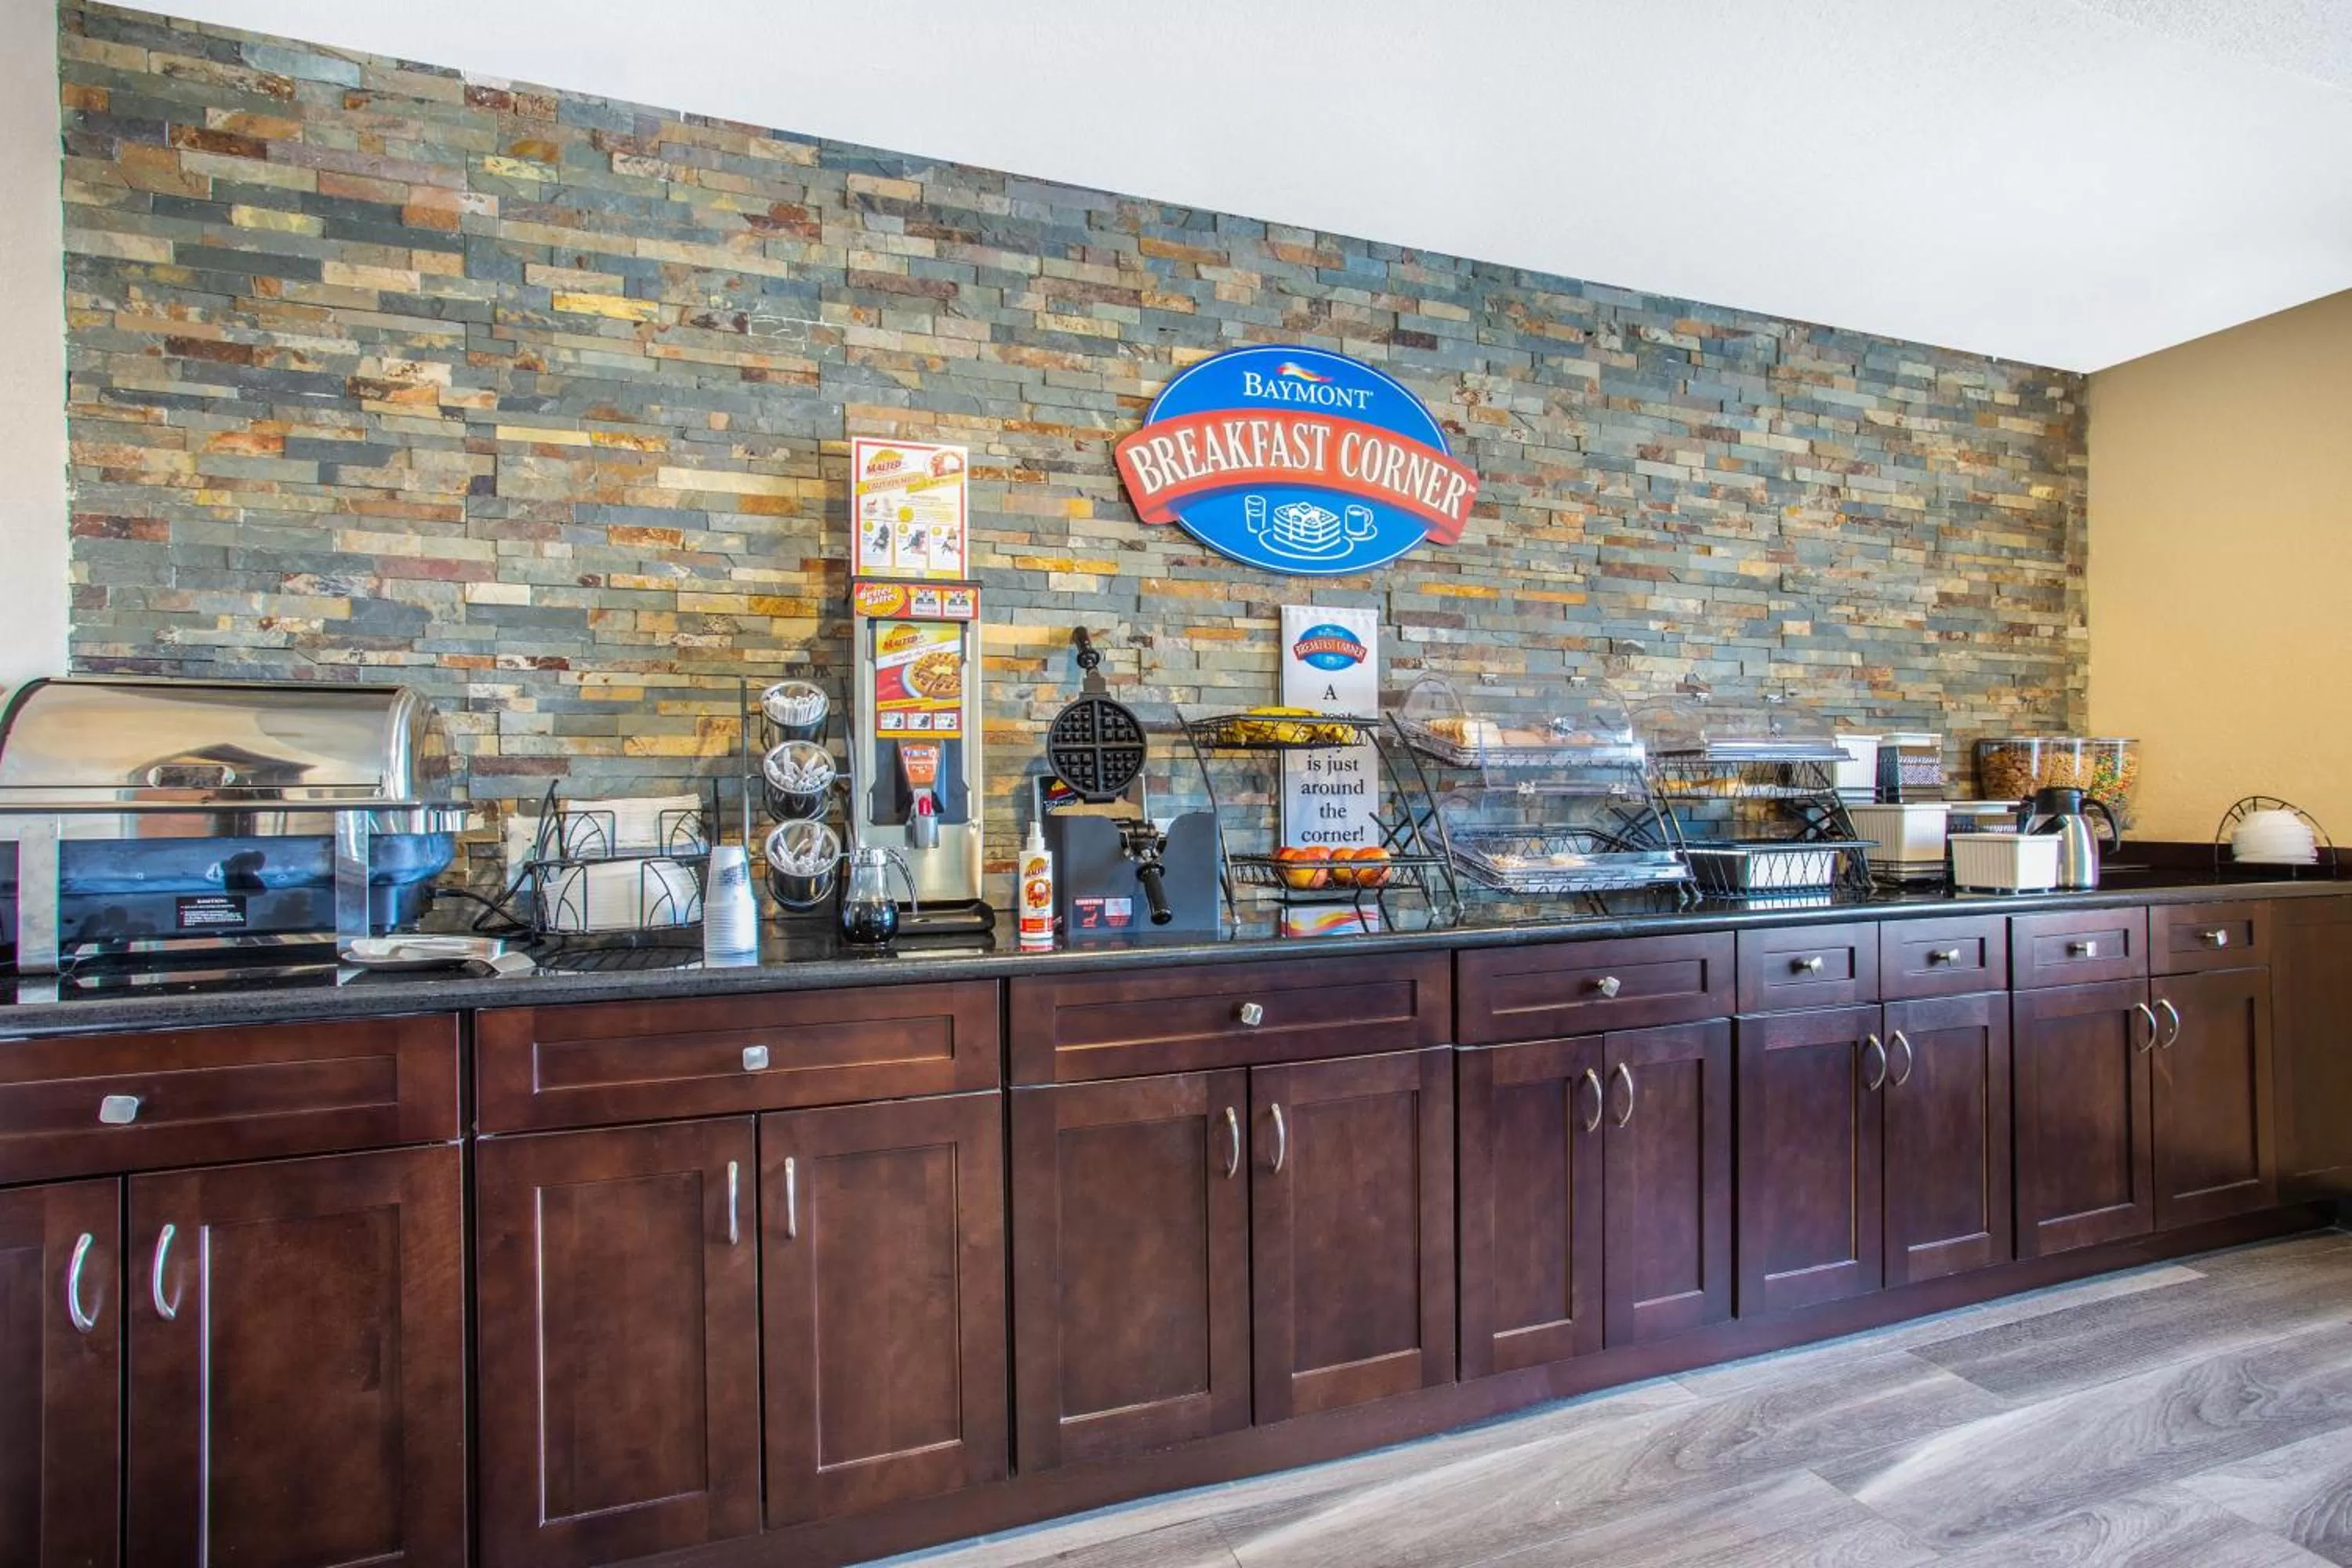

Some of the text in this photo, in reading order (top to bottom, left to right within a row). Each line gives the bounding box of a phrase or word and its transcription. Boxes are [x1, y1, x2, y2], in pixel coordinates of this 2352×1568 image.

[1243, 372, 1370, 409] BAYMONT
[1126, 420, 1469, 520] BREAKFAST CORNER
[1322, 684, 1338, 700] A
[1307, 754, 1359, 775] is just
[1301, 779, 1365, 795] around
[1319, 802, 1348, 819] the
[1301, 826, 1365, 843] corner!
